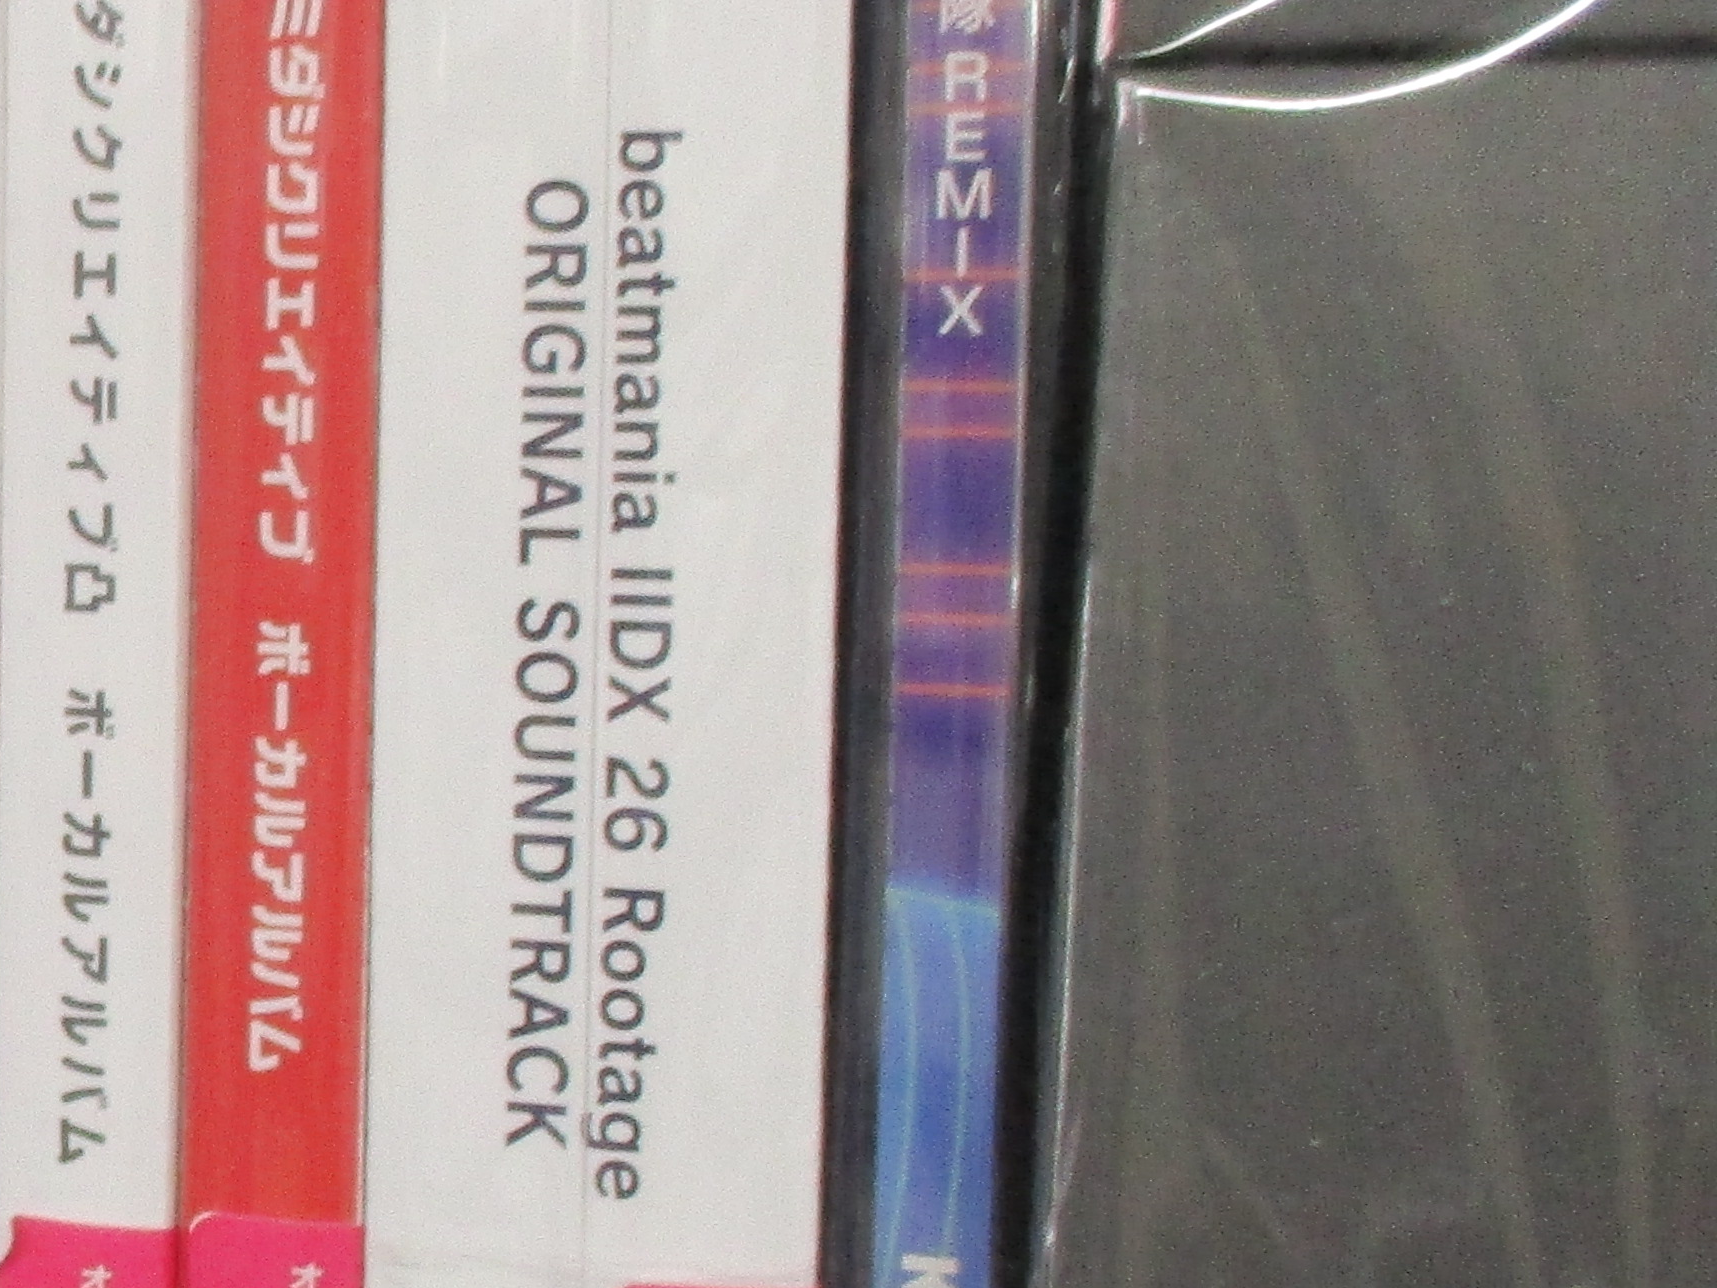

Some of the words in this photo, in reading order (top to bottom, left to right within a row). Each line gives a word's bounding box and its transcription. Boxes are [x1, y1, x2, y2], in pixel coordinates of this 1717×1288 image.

[513, 178, 591, 569] ORIGINAL
[609, 128, 684, 537] beatmania
[600, 755, 672, 856] 26
[607, 563, 677, 724] IIDX
[55, 685, 115, 1167] ボーカルアルバム
[245, 618, 313, 1074] ボーカルアルバム
[502, 598, 581, 1151] SOUNDTRACK
[589, 884, 668, 1204] Rootage
